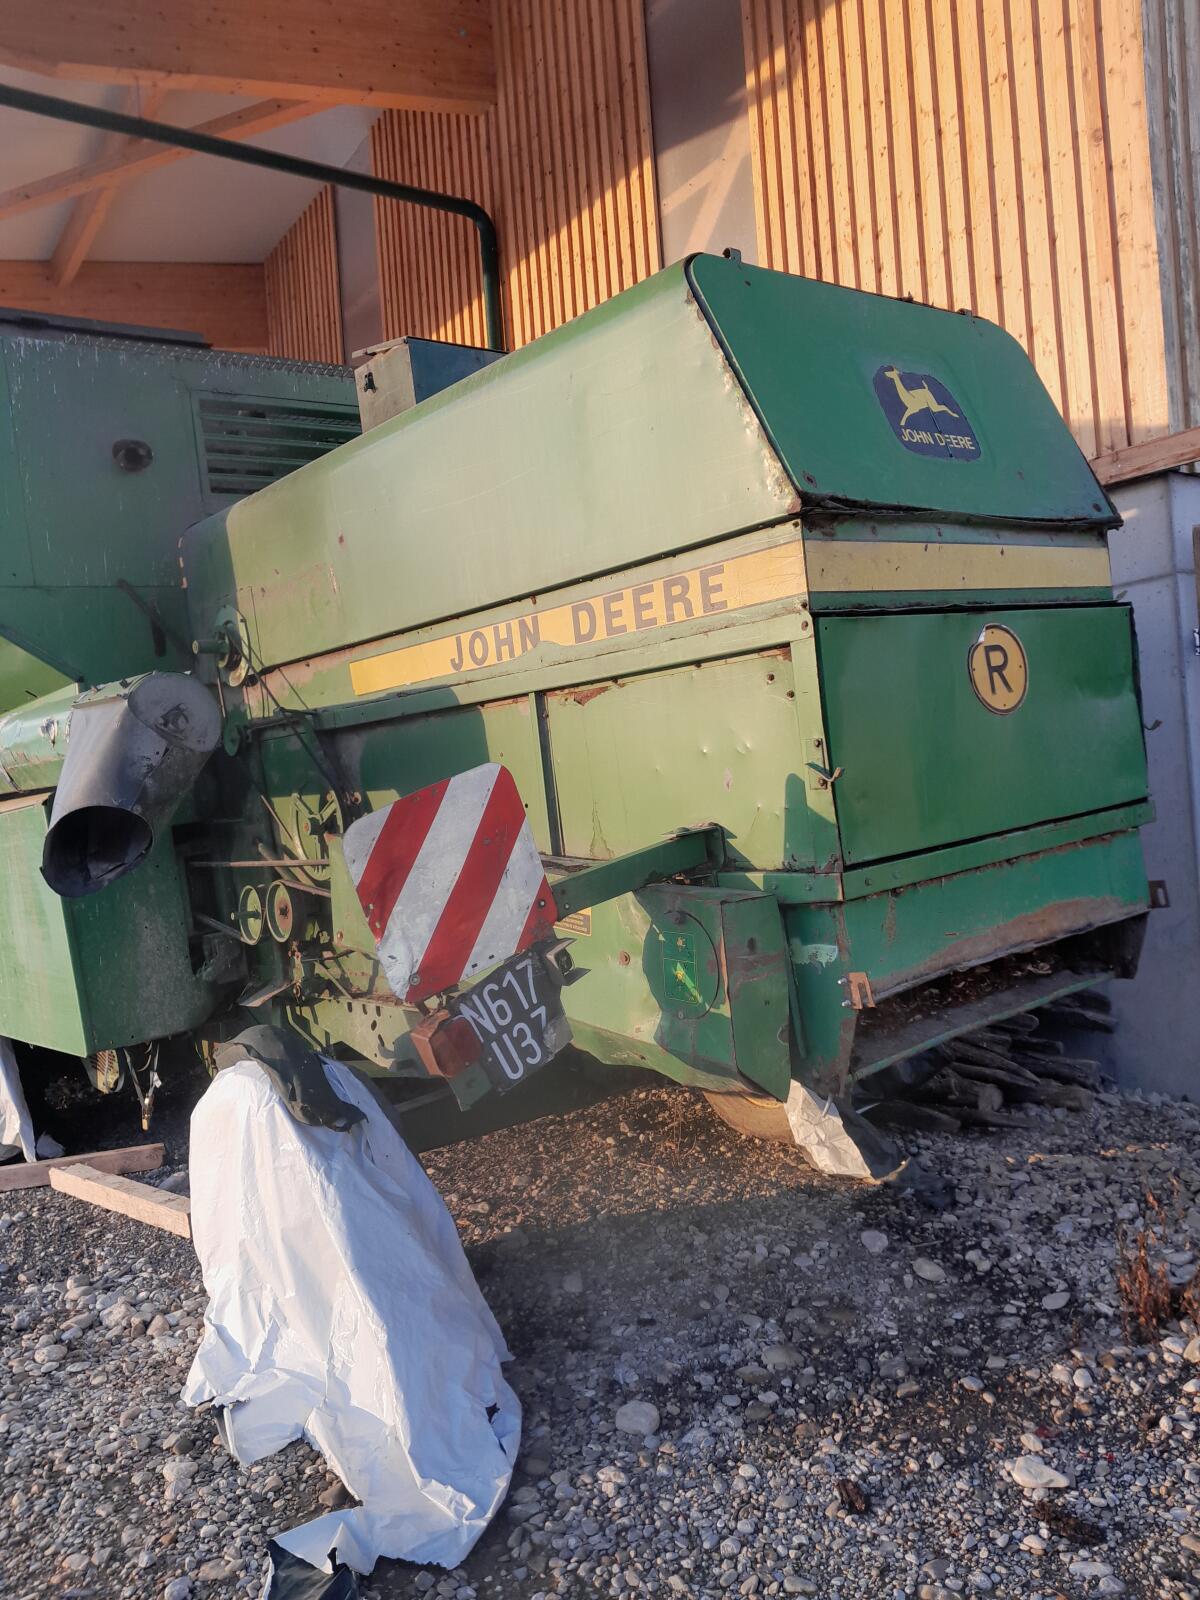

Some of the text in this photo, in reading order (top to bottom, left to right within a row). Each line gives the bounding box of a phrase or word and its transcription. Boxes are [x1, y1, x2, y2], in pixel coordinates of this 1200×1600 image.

[901, 428, 976, 450] JOHN DEERE
[450, 564, 728, 672] JOHN DEERE
[984, 644, 1013, 695] R
[459, 958, 538, 1043] N617
